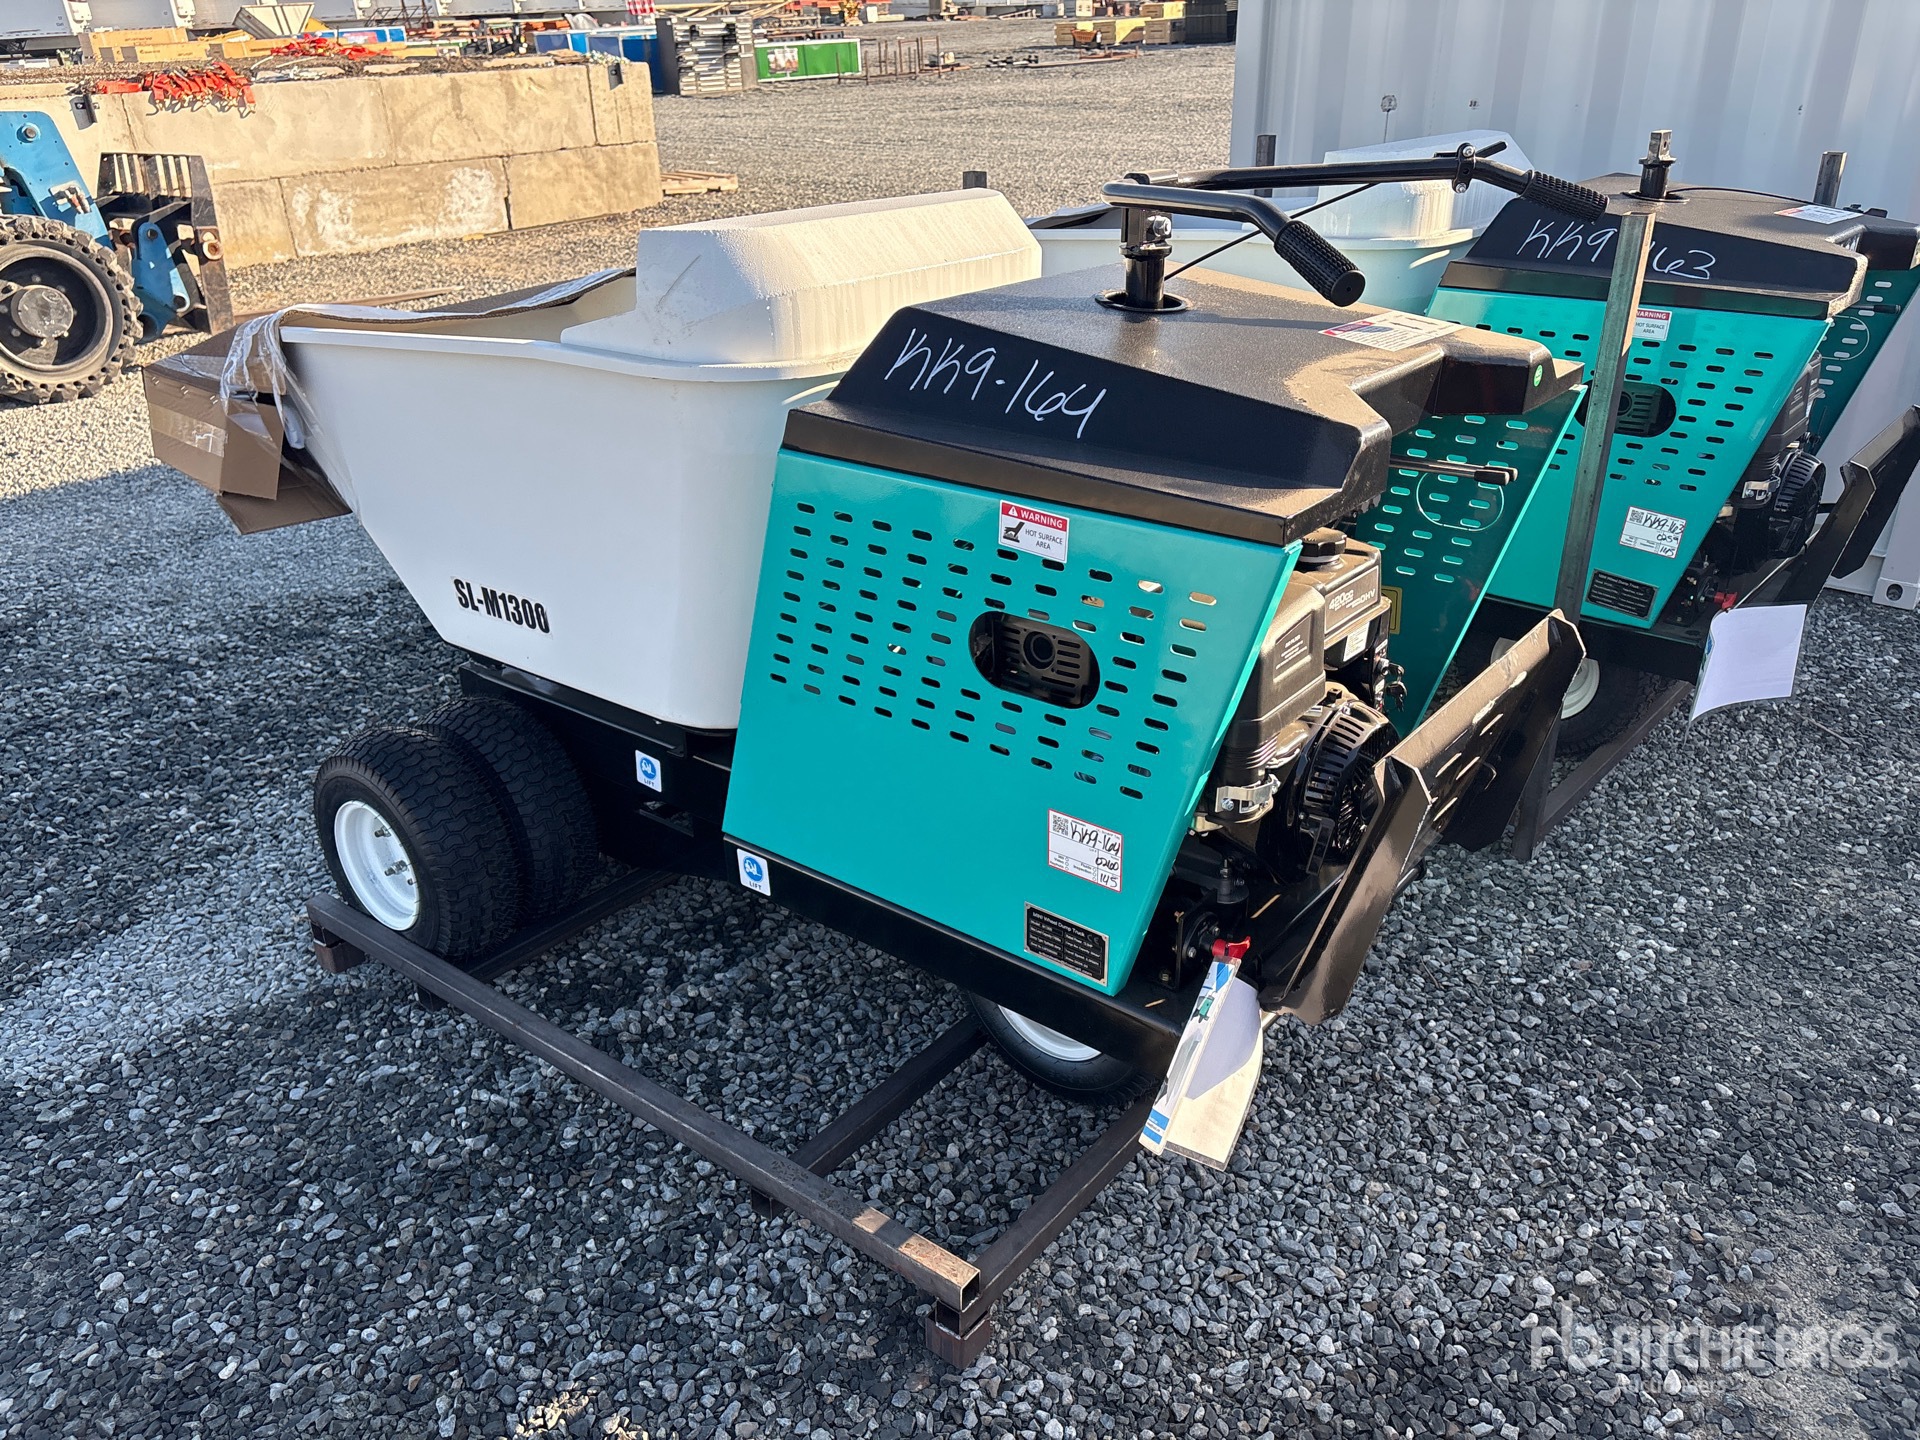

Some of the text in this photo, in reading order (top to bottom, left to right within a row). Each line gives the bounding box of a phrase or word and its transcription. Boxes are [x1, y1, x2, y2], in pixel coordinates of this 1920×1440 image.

[1020, 509, 1063, 528] WARNING
[1025, 529, 1063, 545] HOT SURFACE
[1035, 540, 1051, 550] AREA
[1329, 589, 1354, 610] 420cc
[1360, 588, 1375, 603] OHV
[454, 578, 550, 633] SL-M1300
[644, 778, 655, 787] LIFT
[749, 881, 762, 890] LIFT
[1100, 873, 1118, 887] 145
[1058, 922, 1072, 932] Dump
[1072, 928, 1085, 937] Truck
